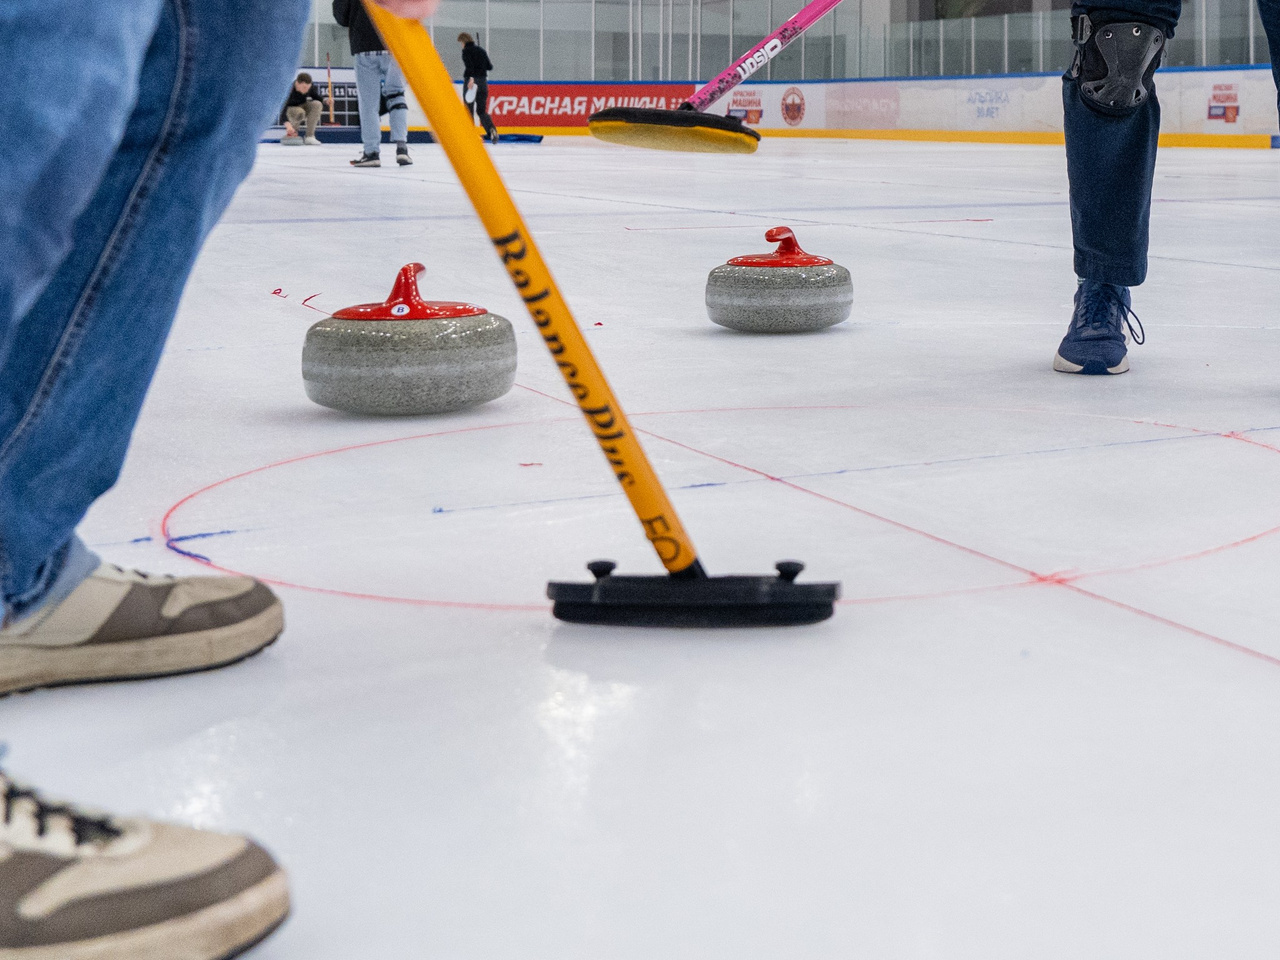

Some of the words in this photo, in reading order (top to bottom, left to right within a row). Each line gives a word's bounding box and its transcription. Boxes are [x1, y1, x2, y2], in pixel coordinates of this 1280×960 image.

[736, 38, 781, 79] Olson
[334, 87, 344, 96] 11
[488, 96, 586, 115] КРАСНАЯ
